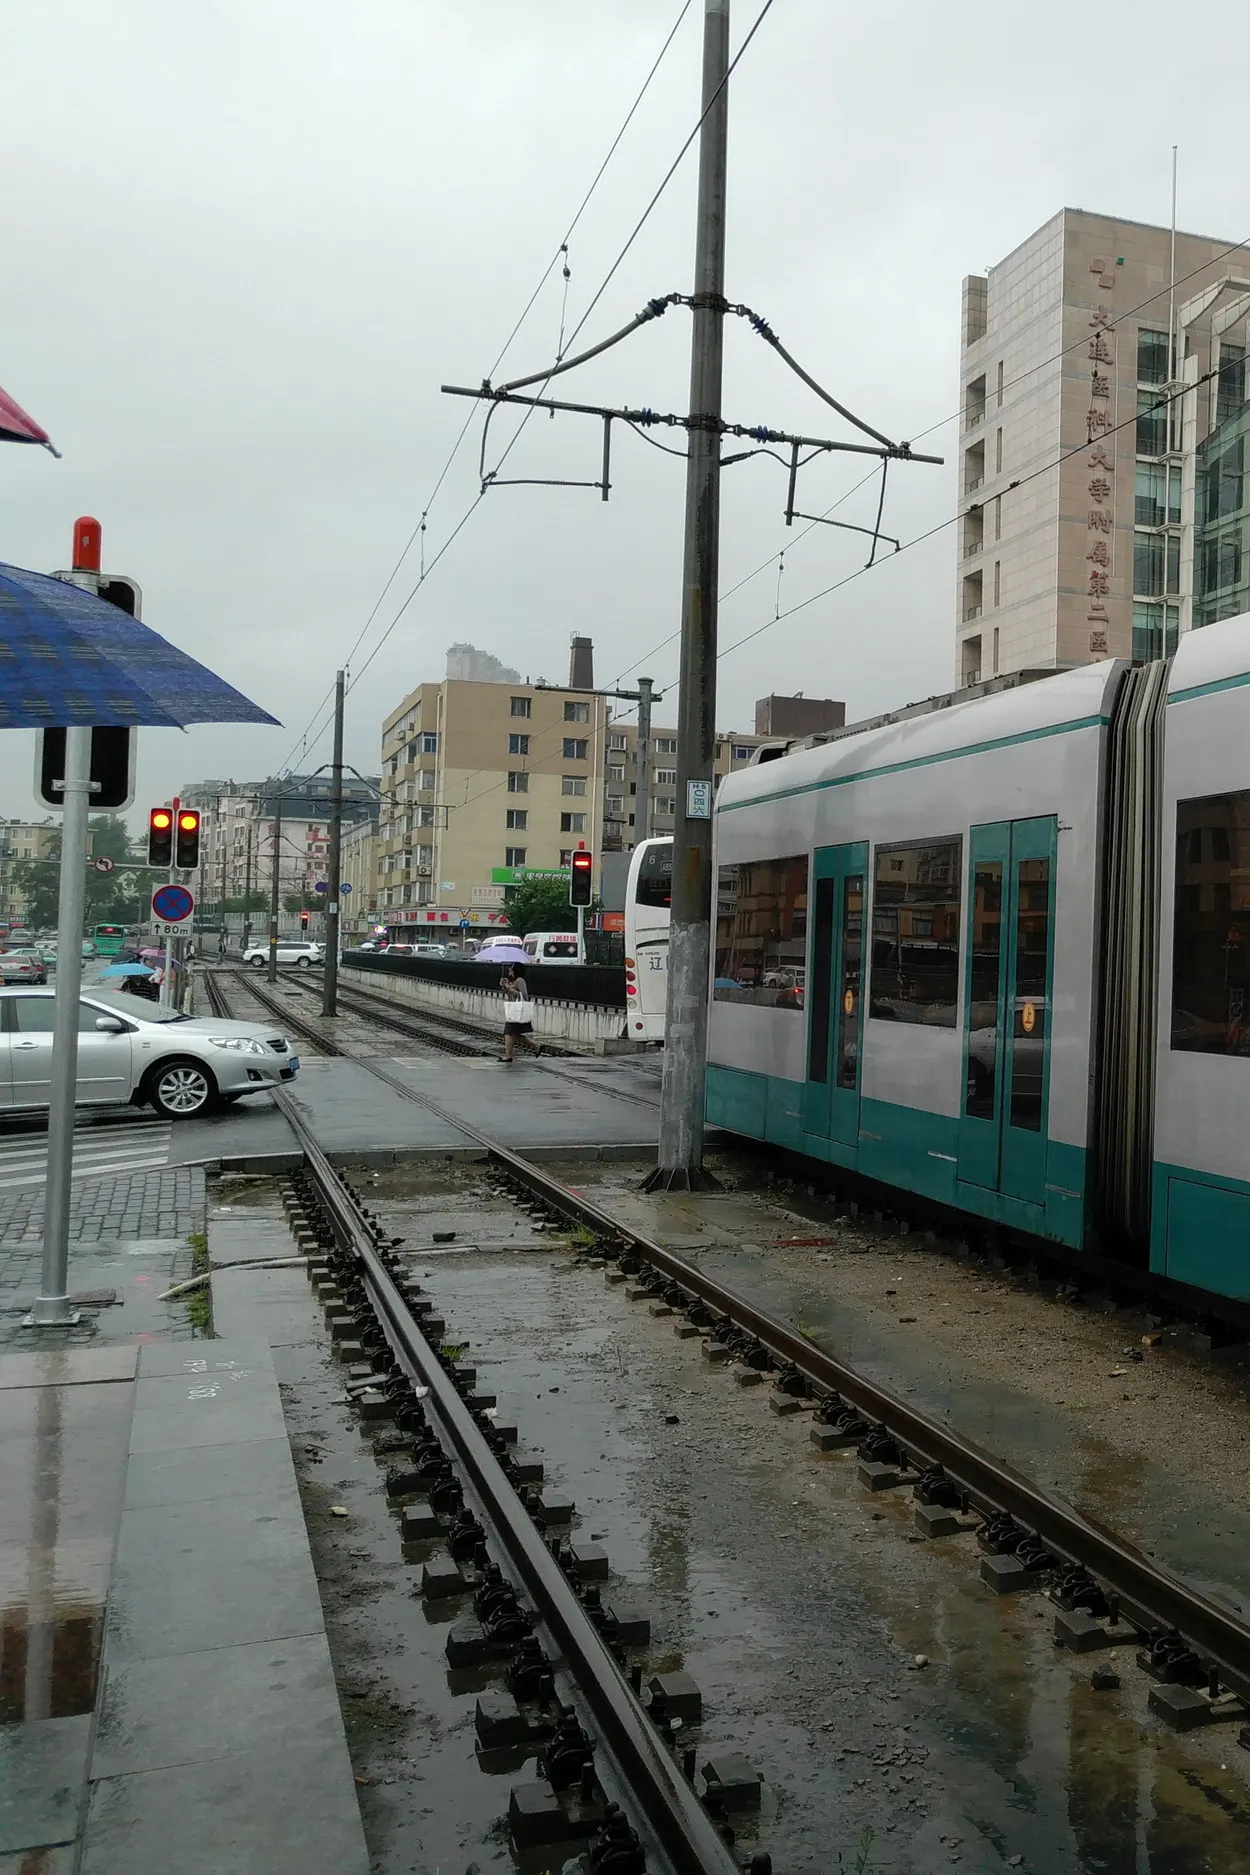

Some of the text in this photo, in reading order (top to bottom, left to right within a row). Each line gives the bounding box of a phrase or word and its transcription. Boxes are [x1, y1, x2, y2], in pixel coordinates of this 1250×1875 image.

[1086, 304, 1115, 663] 大连医科大学附属第二医
[164, 925, 188, 935] 80m
